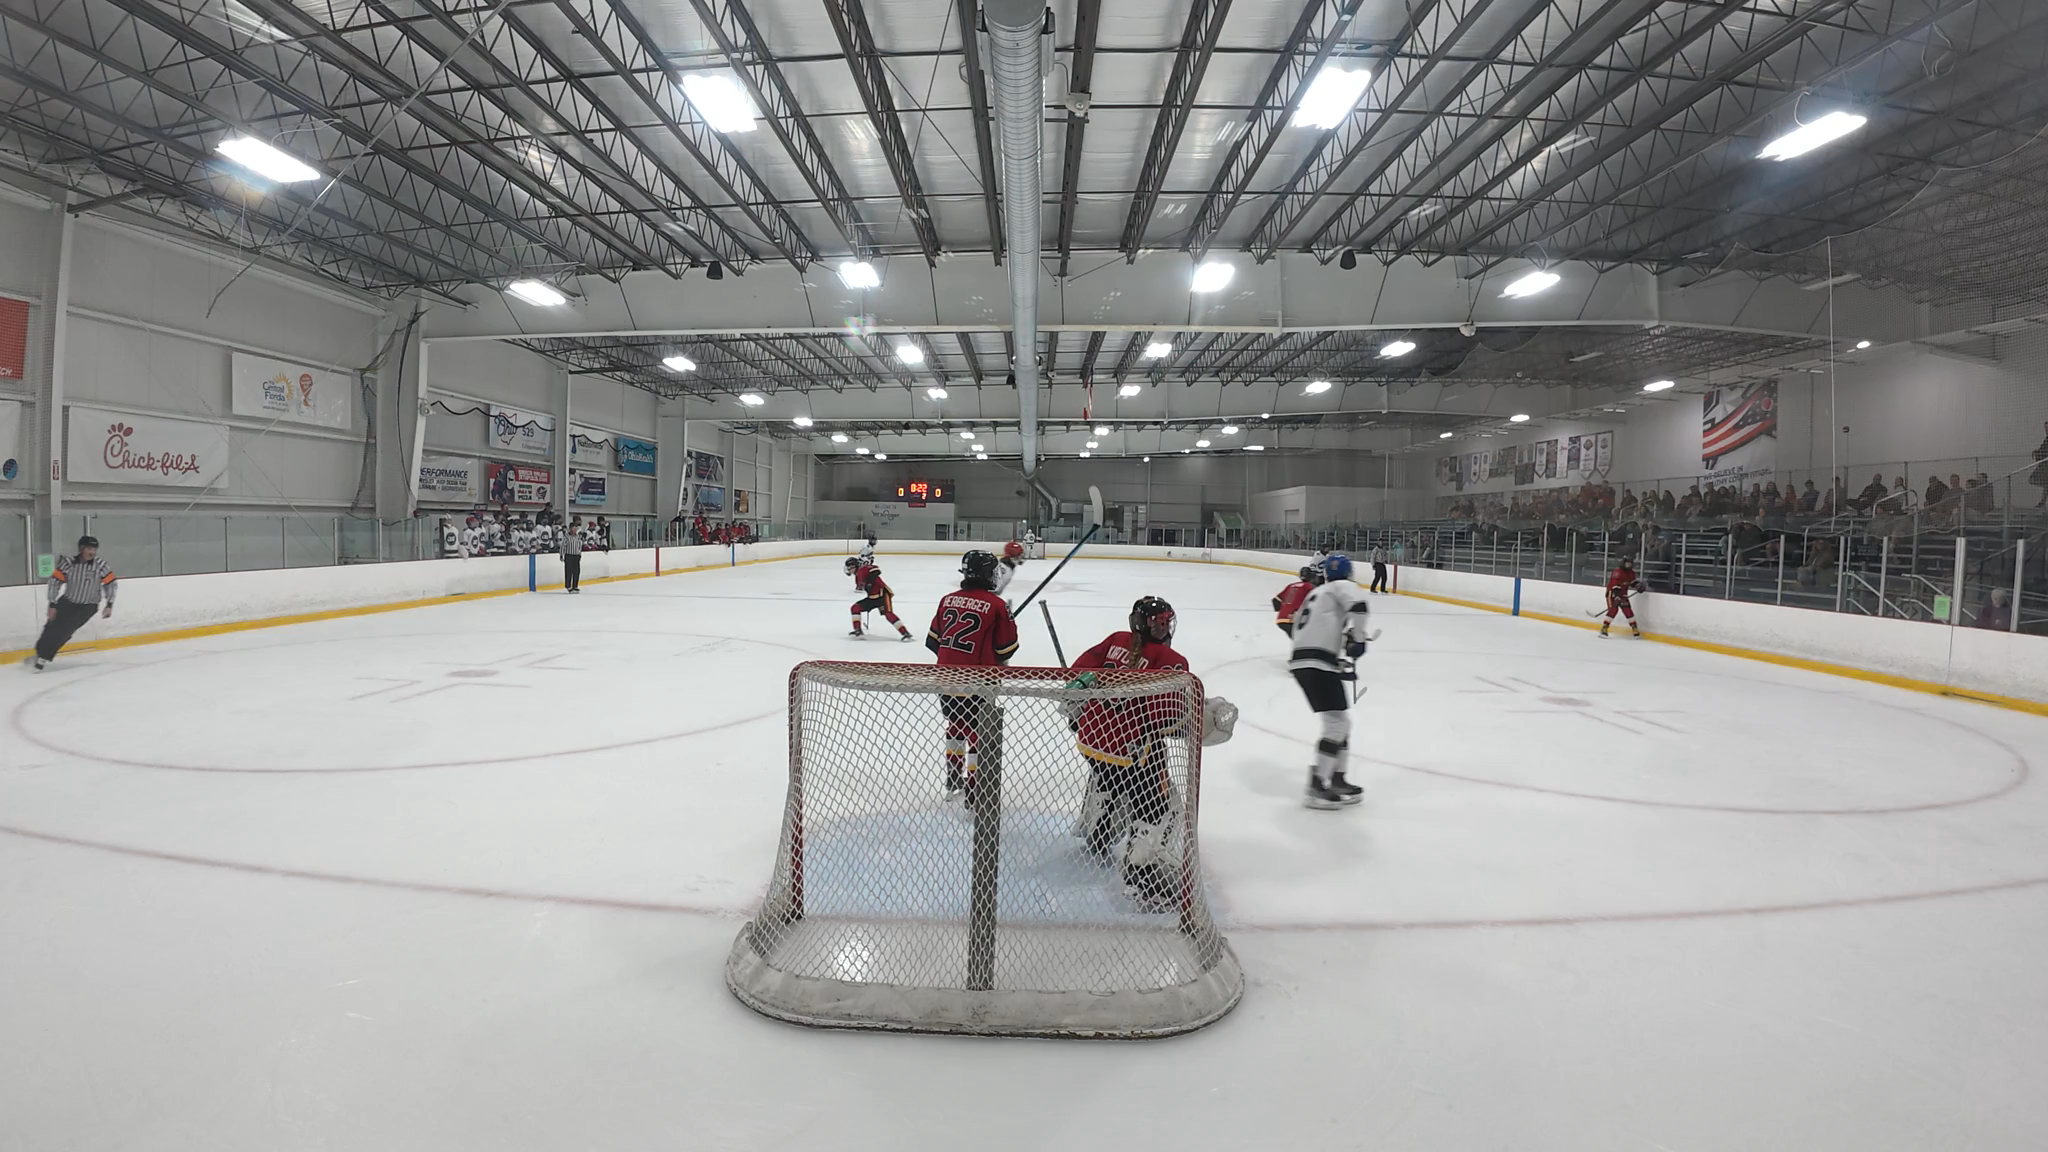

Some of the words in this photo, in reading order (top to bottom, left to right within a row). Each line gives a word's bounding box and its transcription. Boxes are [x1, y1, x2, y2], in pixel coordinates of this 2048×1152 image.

[103, 433, 200, 476] Chick-fil-A
[898, 487, 904, 497] 0
[935, 488, 941, 498] 0
[940, 607, 983, 654] 22
